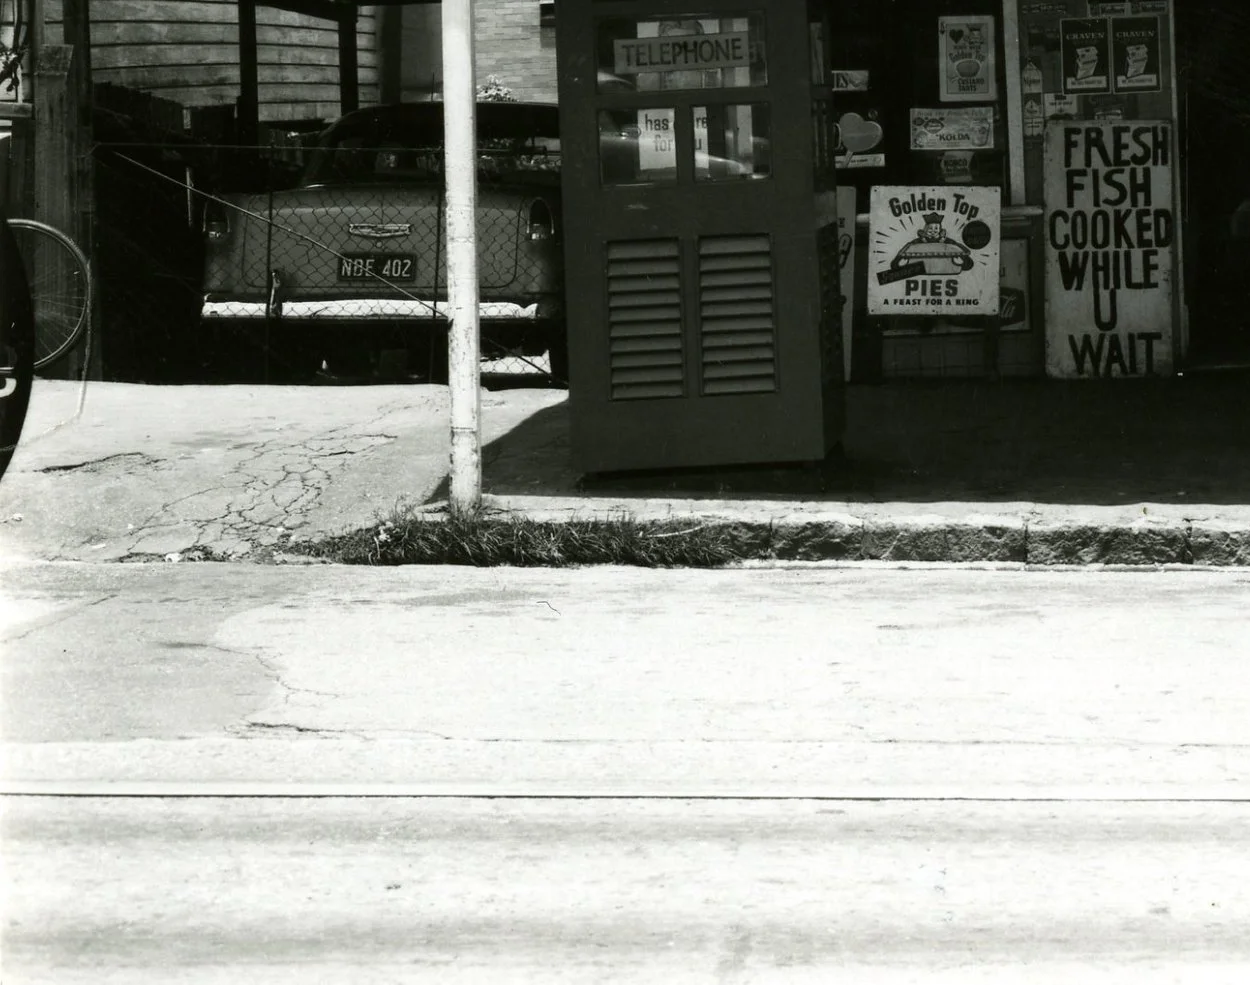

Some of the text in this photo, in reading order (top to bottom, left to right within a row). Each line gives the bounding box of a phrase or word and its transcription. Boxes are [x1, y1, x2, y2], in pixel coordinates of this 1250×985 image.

[1065, 31, 1105, 40] CRAVEN
[1115, 30, 1155, 39] CRAVEN
[621, 37, 744, 67] TELEPHONE
[644, 113, 669, 131] has
[1064, 126, 1168, 167] FRESH
[1066, 167, 1151, 207] FISH
[889, 192, 980, 220] Golden Top
[1049, 208, 1172, 250] COOKED
[381, 258, 412, 278] 402
[1058, 249, 1159, 290] WHILE
[883, 298, 980, 306] A FEAST FOR A KING
[904, 278, 959, 297] PIES
[1093, 287, 1118, 332] U
[1068, 332, 1162, 375] WAIT
